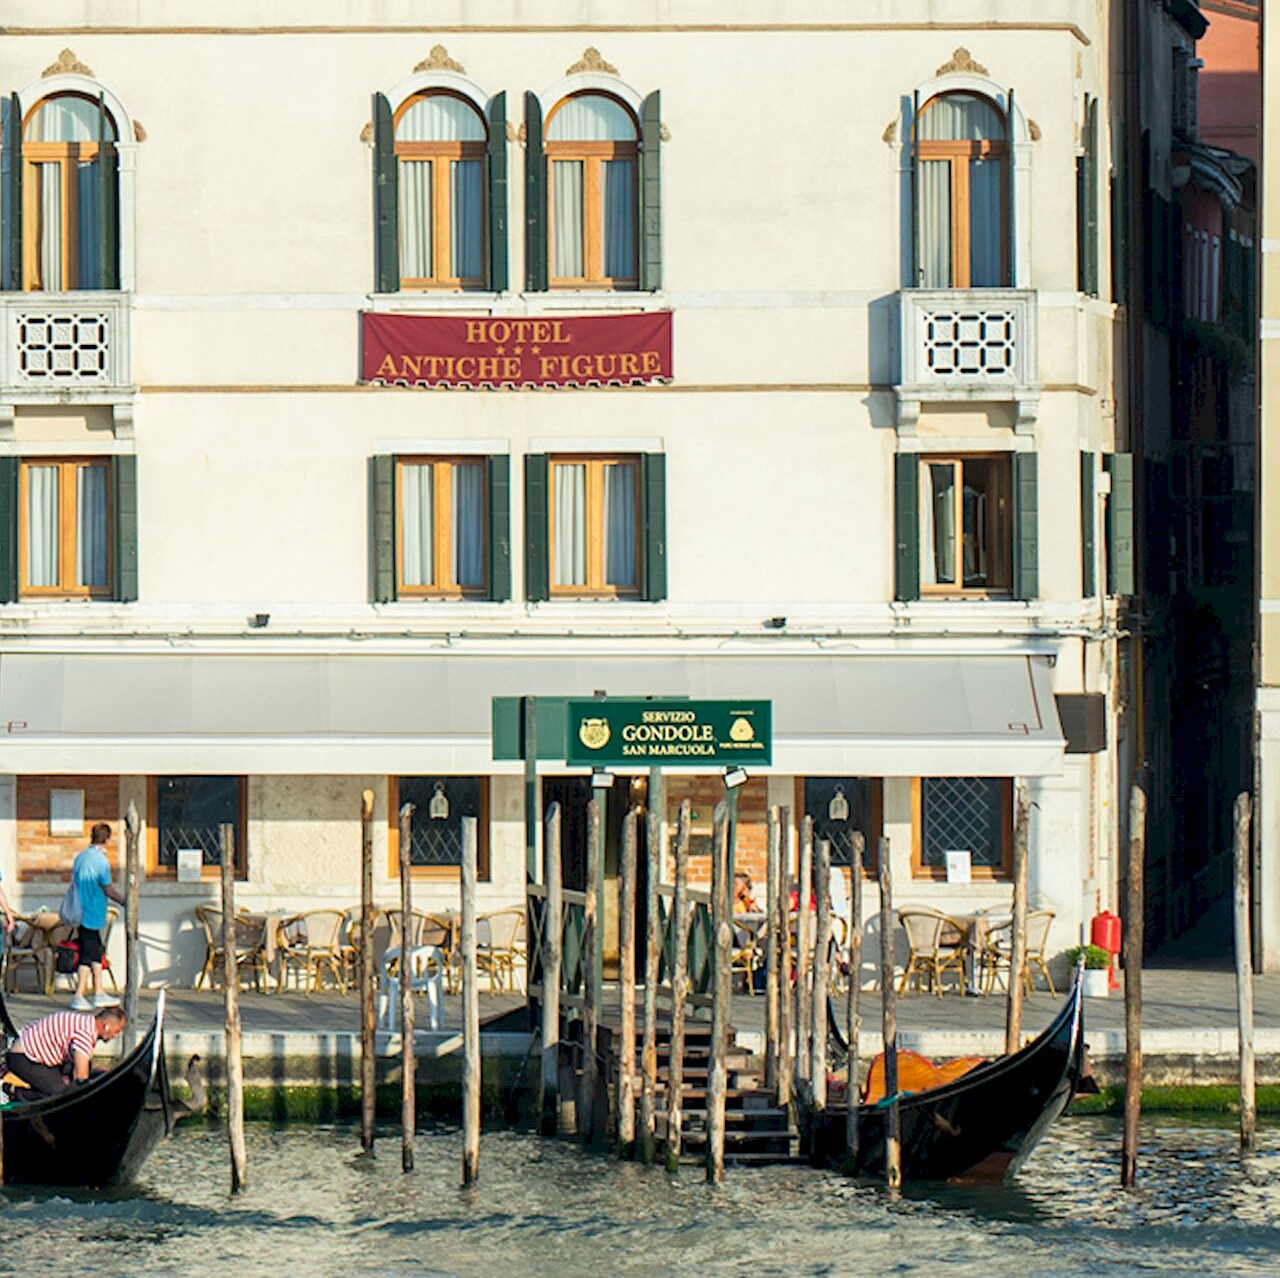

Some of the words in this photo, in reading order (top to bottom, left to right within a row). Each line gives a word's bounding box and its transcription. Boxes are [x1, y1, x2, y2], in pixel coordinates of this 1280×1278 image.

[465, 321, 571, 344] HOTEL
[376, 353, 522, 379] ANTICHE
[540, 351, 661, 378] FIGURE
[642, 711, 695, 722] SERVIZIO
[622, 725, 713, 741] GONDOLE
[622, 744, 646, 755] SAN
[649, 744, 715, 755] MARCUOLA
